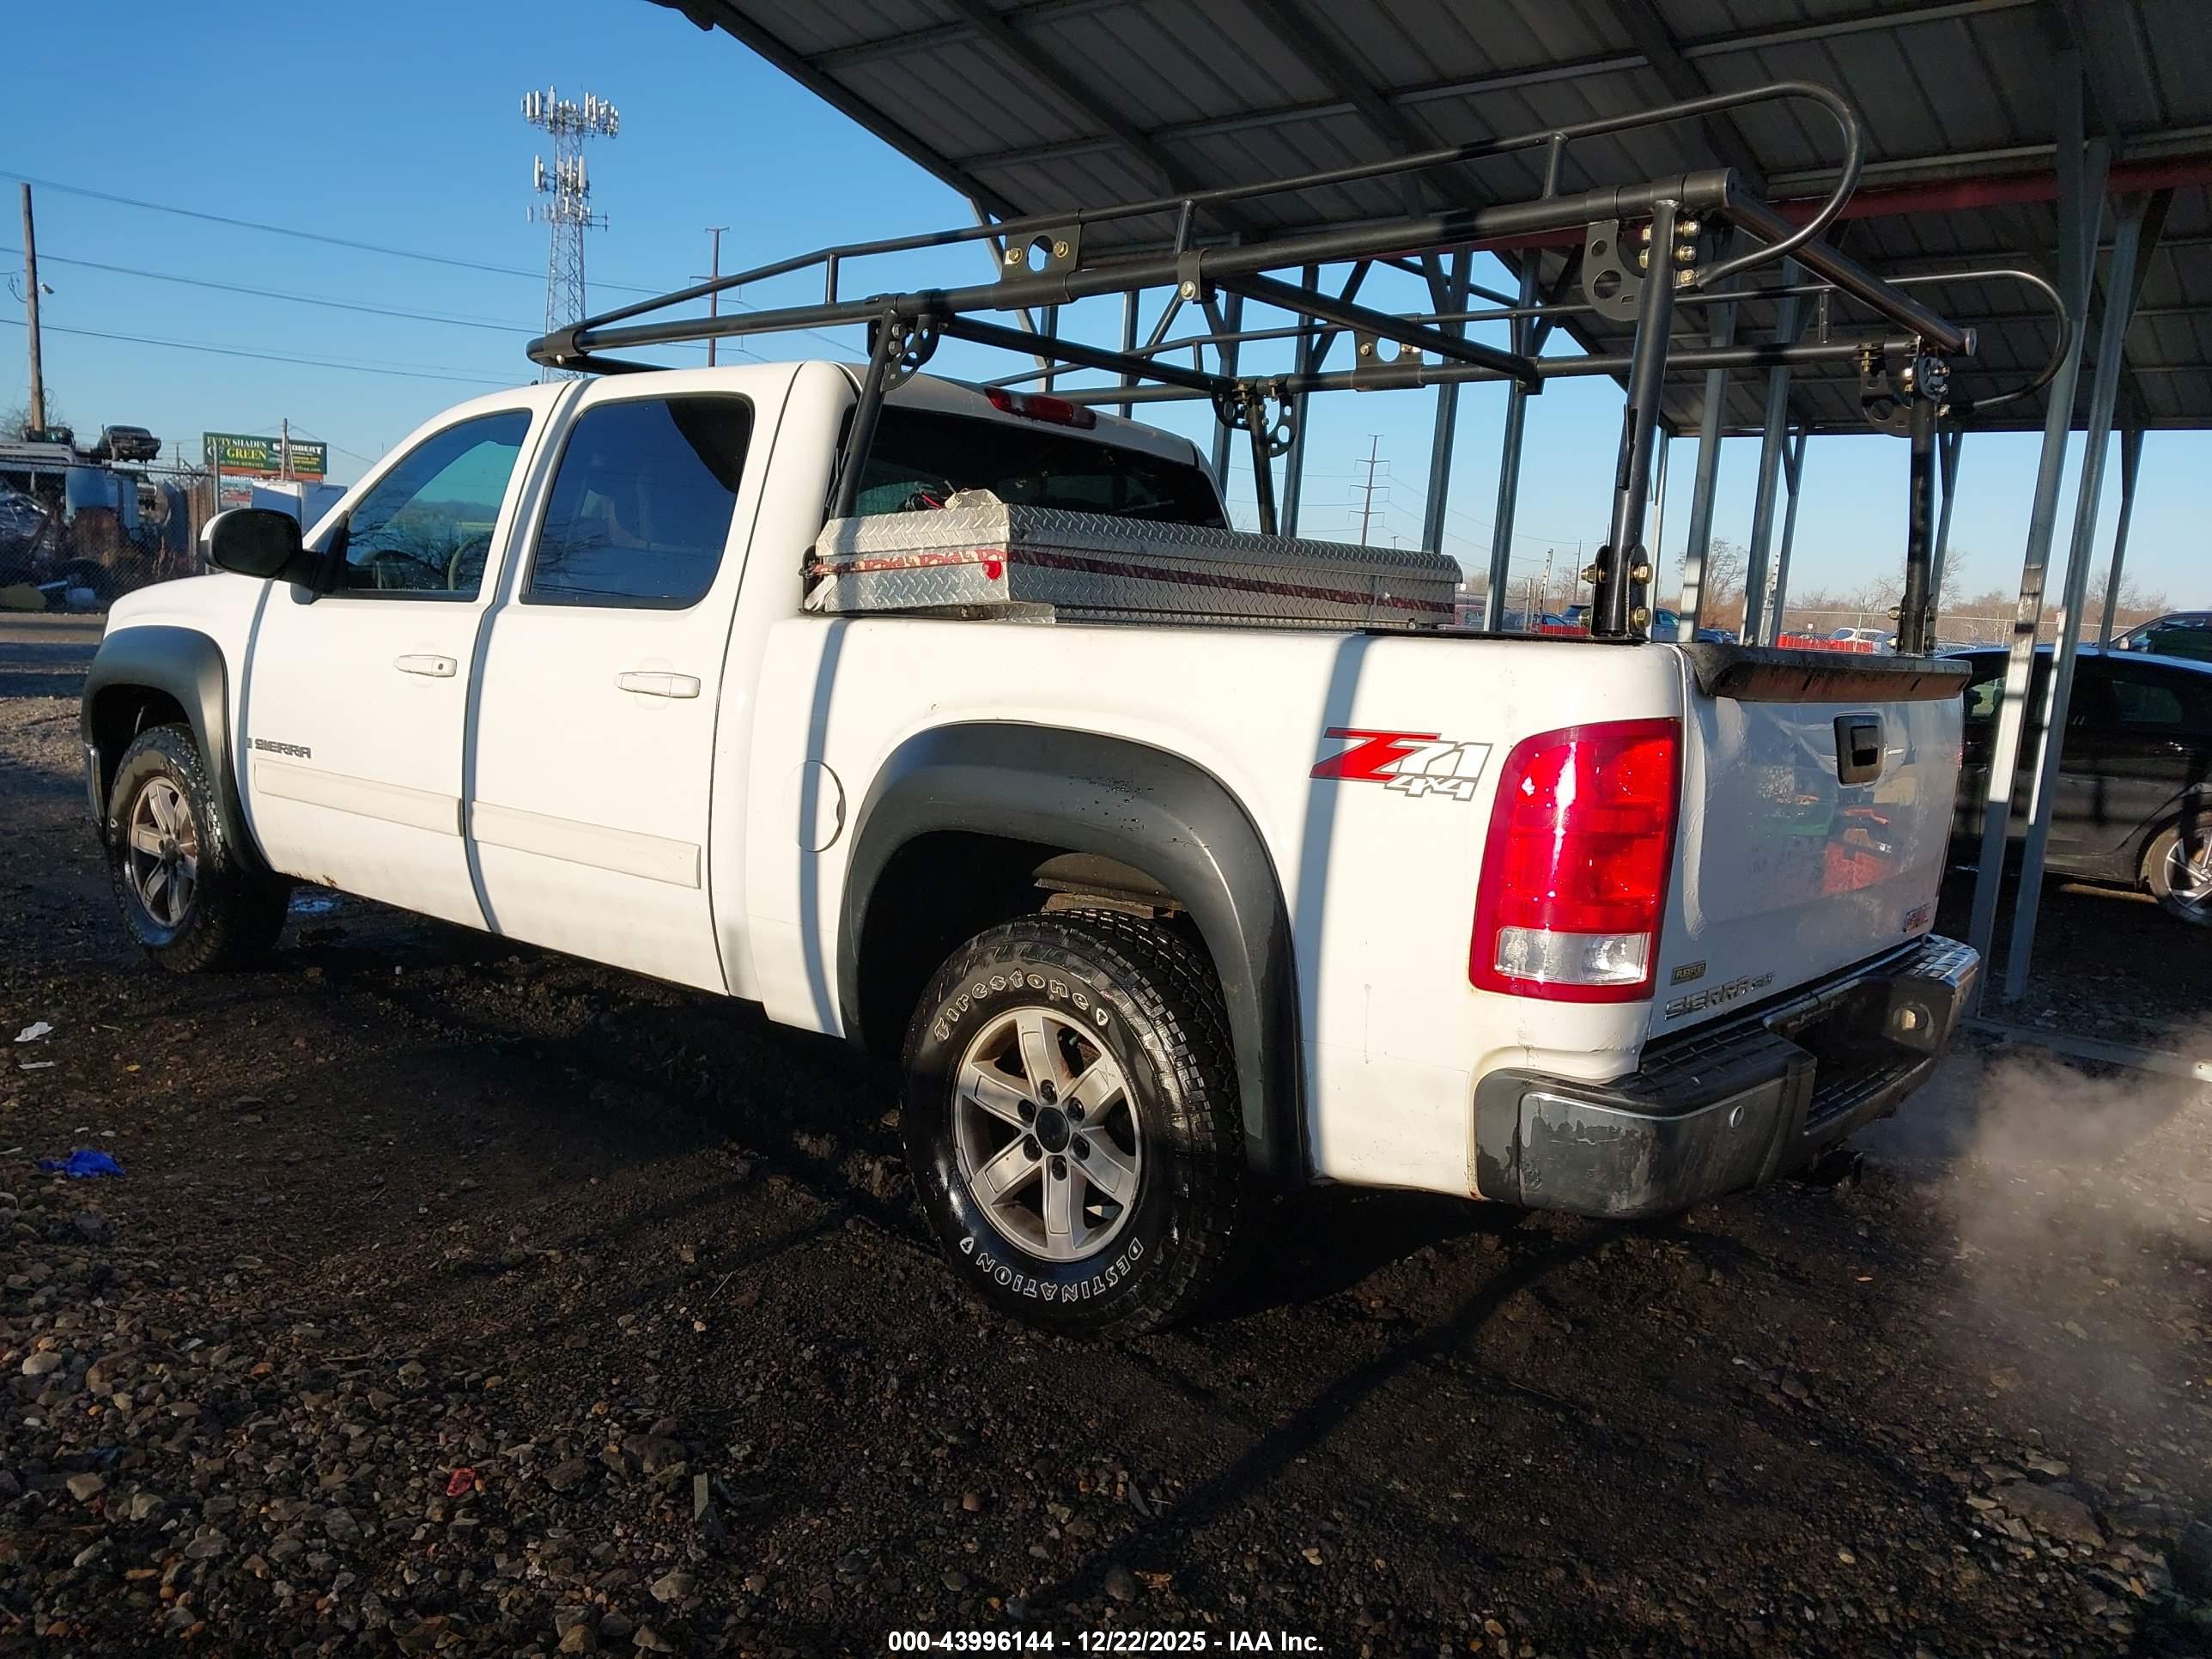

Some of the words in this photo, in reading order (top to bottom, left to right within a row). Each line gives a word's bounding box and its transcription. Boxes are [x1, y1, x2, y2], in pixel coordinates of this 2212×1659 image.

[227, 447, 267, 460] GREEN
[232, 439, 267, 449] SHADES
[255, 738, 311, 759] SIERRA
[1309, 726, 1494, 784] Z71
[934, 969, 1090, 1042] Firestone
[975, 1237, 1145, 1303] DESTINATION
